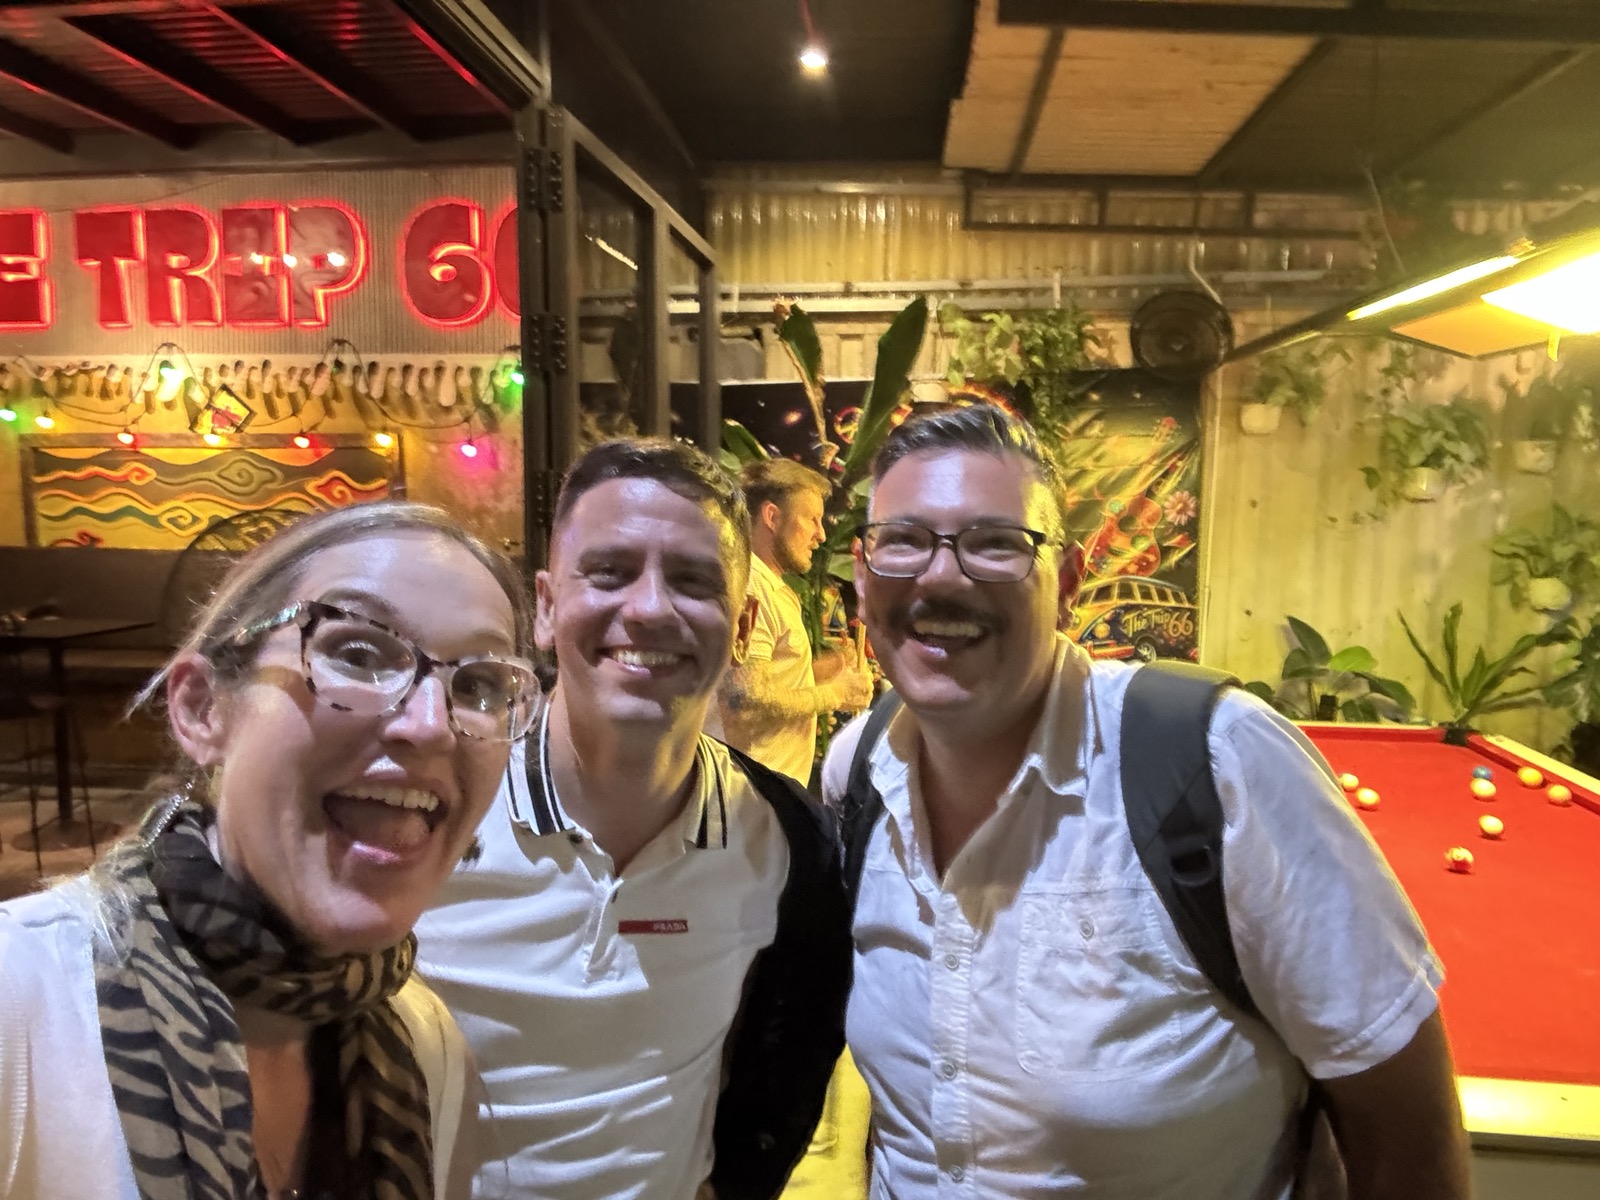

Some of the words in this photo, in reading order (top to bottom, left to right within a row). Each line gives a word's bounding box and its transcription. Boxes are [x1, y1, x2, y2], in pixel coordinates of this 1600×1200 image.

[75, 202, 367, 328] TRIP
[1121, 610, 1148, 638] The
[1143, 608, 1171, 630] Trip
[1169, 611, 1194, 637] 66
[653, 922, 687, 931] PRADA
